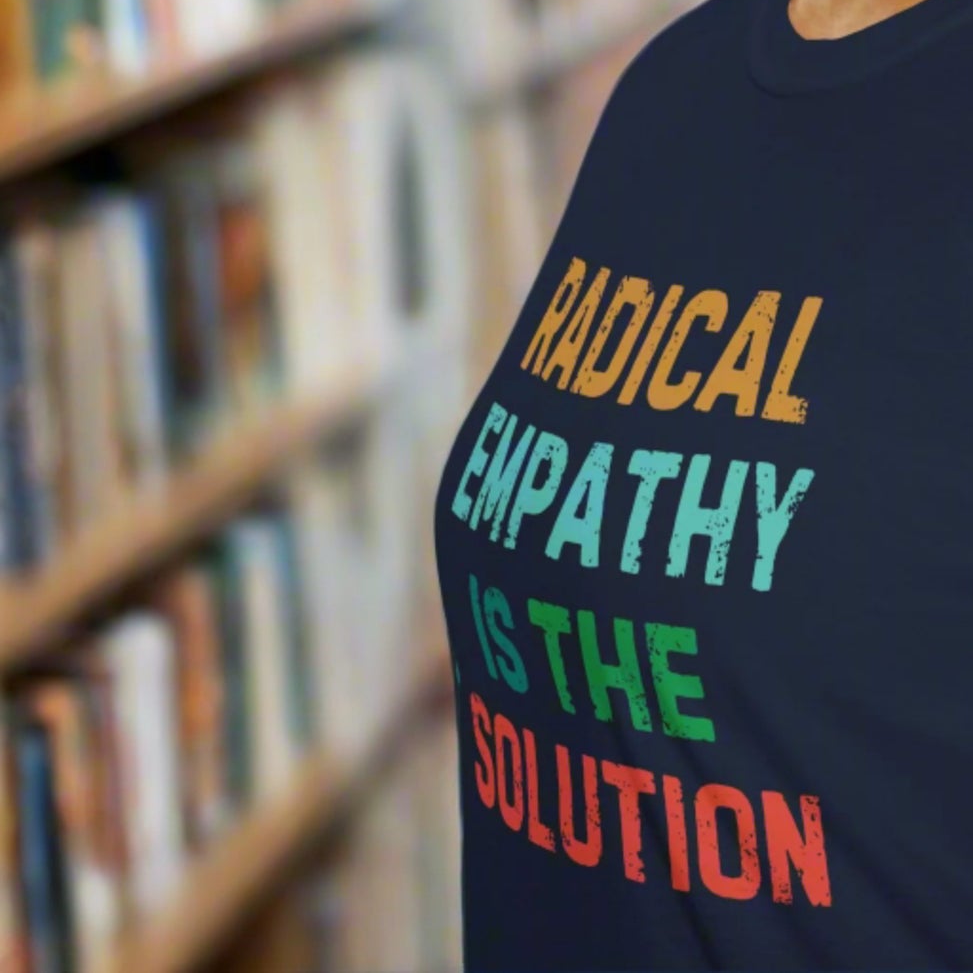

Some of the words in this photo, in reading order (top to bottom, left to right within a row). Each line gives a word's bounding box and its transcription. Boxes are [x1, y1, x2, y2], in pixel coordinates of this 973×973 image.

[520, 257, 823, 424] RADICAL
[451, 402, 815, 591] EMPATHY
[469, 574, 529, 693] IS
[527, 598, 716, 742] THE
[470, 692, 831, 907] SOLUTION
